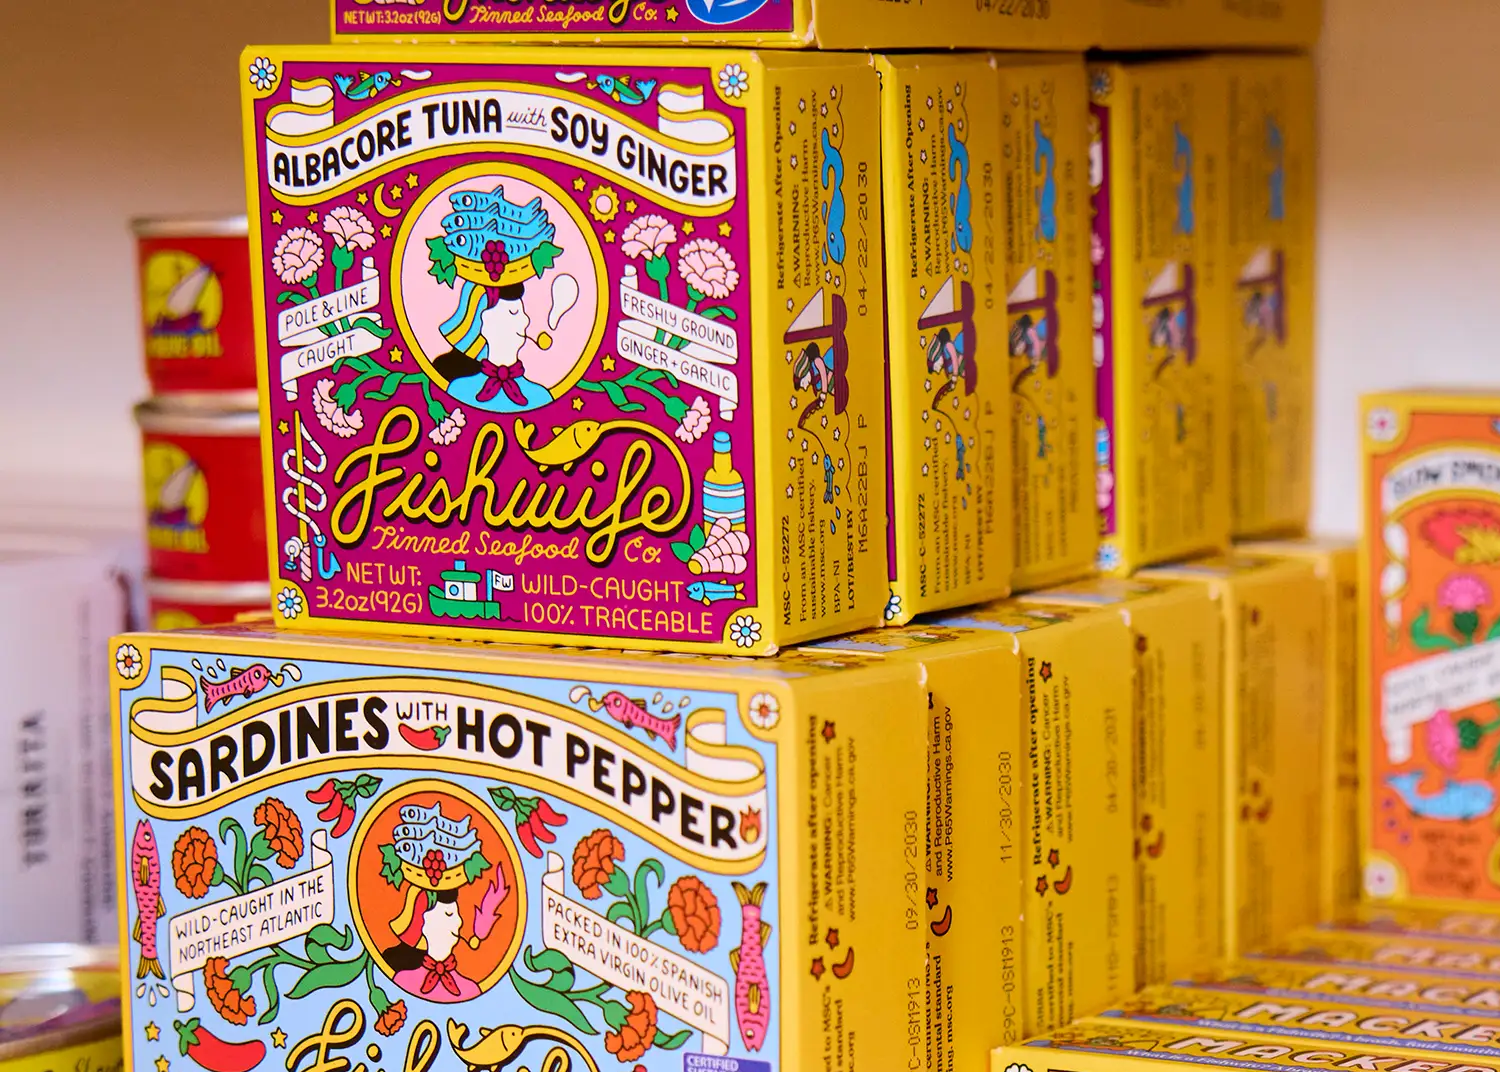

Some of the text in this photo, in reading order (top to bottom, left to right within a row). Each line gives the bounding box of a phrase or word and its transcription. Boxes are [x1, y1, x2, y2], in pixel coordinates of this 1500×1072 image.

[469, 5, 533, 24] Tinned
[536, 5, 604, 29] Seafood
[633, 4, 658, 21] Co.
[273, 98, 728, 197] ALBACORE TUNA with SOY GINGER
[773, 85, 785, 290] Refrigerate After Opening
[792, 184, 801, 274] WARNING:
[285, 307, 319, 330] POLE
[623, 293, 733, 349] FRESHLY GROUND
[297, 334, 355, 368] CAUGHT
[621, 337, 667, 368] GINGER
[682, 361, 730, 392] GARLIC
[331, 406, 691, 563] Fishwife
[347, 562, 422, 586] NET WT:
[372, 526, 662, 564] Tinned Seafood Co.
[781, 515, 792, 625] MSC-C-52272
[818, 519, 827, 617] www.msc.org
[845, 509, 854, 610] LOT/BEST BY
[494, 575, 512, 590] FW
[521, 573, 684, 603] WILD-CAUGHT
[833, 558, 841, 614] BPA-NI
[522, 603, 713, 635] 100% TRACEABLE
[149, 697, 738, 850] SARDINES WITH HOT PEPPER
[999, 751, 1013, 863] 11/30/2030
[905, 810, 919, 930] 09/30/2030
[175, 875, 324, 939] WILD-CAUGHT IN THE
[179, 902, 322, 963] NORTHEAST ATLANTIC
[548, 897, 722, 1002] PACKED IN 100% SPANISH
[554, 925, 715, 1024] EXTRA VIRGIN OLIVE OIL
[687, 1056, 739, 1071] CERTIFIED
